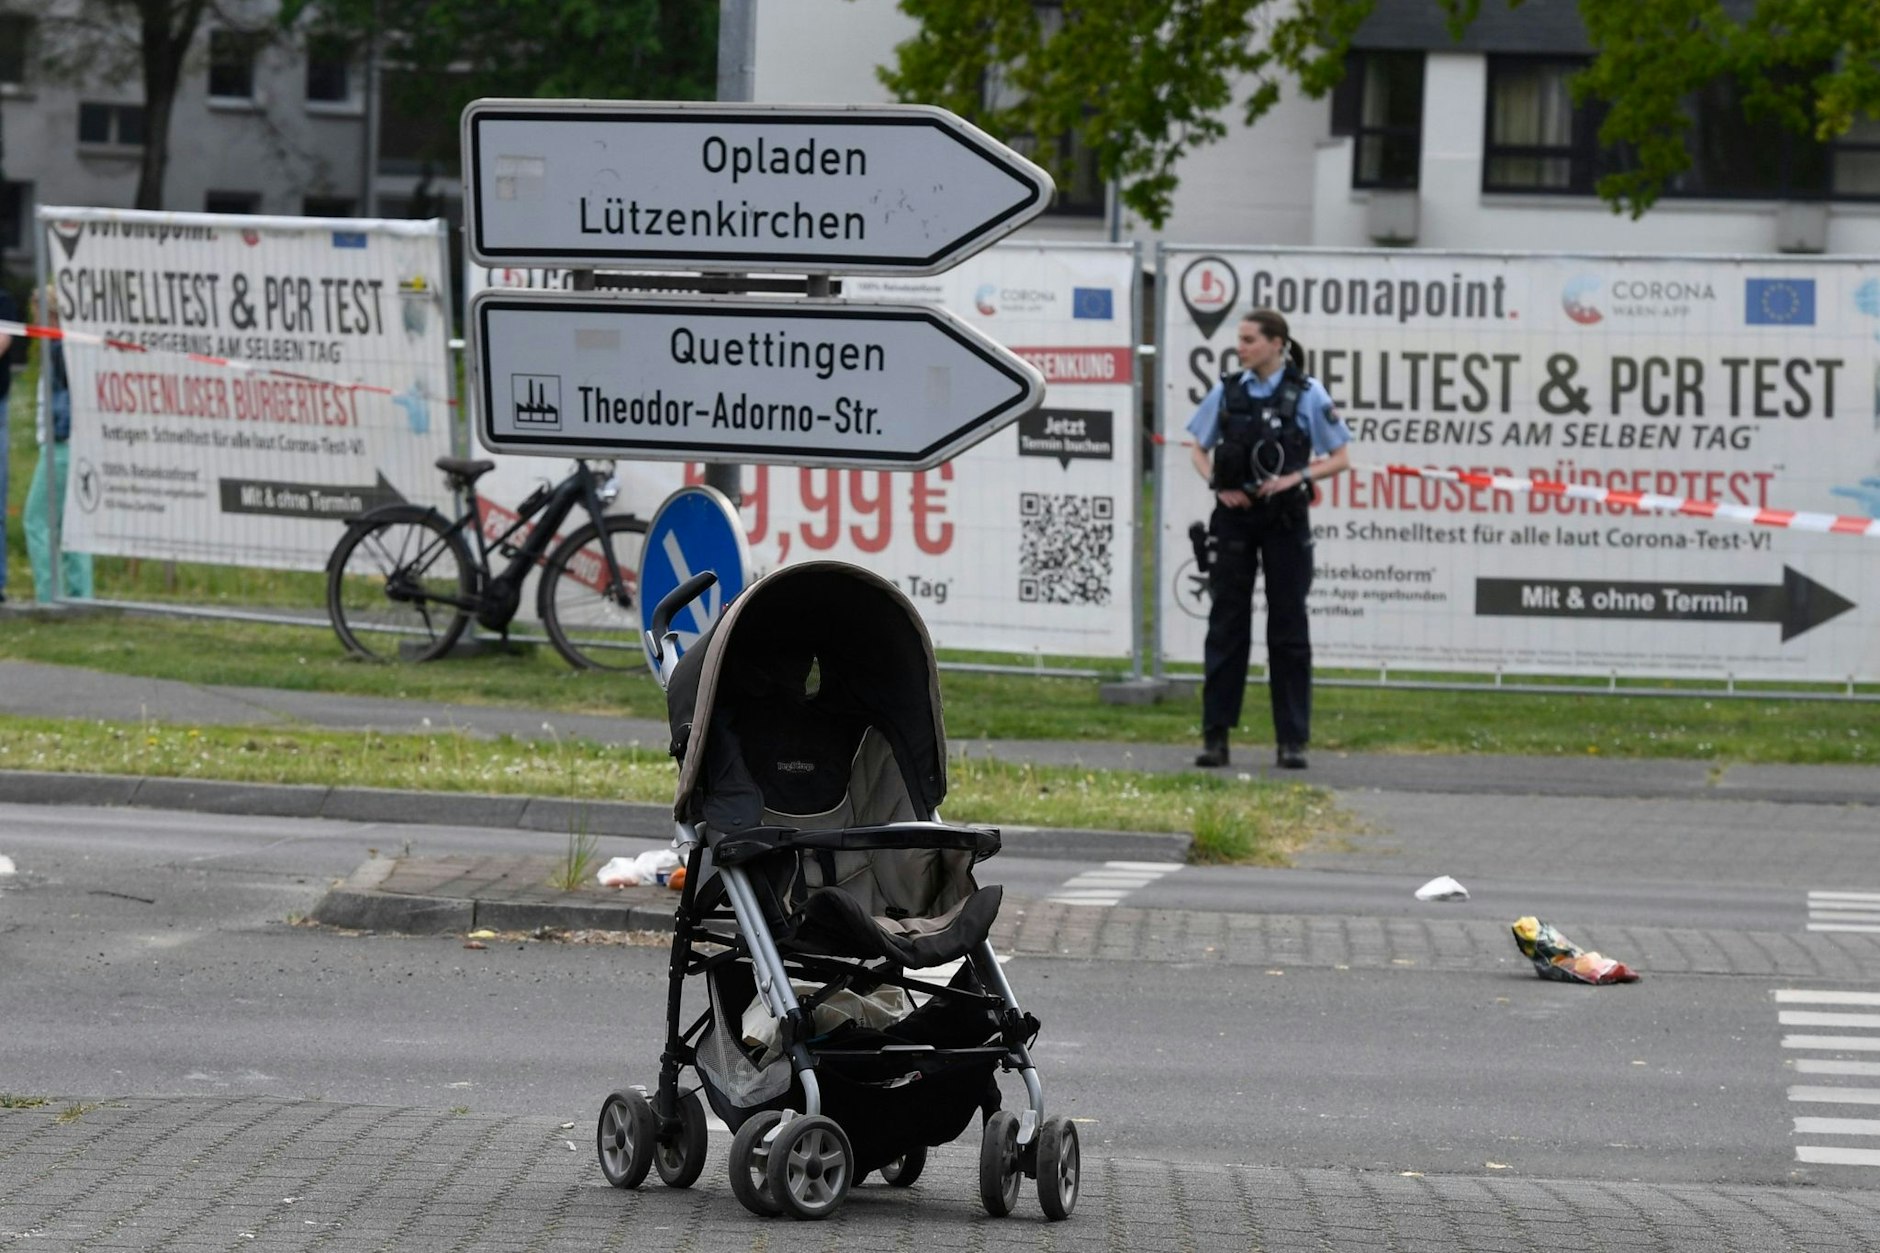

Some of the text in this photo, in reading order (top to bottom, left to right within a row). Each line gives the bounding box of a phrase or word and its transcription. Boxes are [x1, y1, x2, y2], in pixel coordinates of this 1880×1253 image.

[702, 136, 866, 183] Opladen
[580, 198, 866, 240] Lützenkirchen
[58, 268, 383, 335] SCHNELLTEST & PCR TEST
[1252, 271, 1519, 323] Coronapoint.
[1613, 281, 1715, 300] CORONA
[140, 331, 212, 358] ERGEBNIS
[217, 337, 242, 358] AM
[246, 338, 302, 362] SELBEN
[671, 328, 885, 378] Quettingen
[96, 371, 229, 419] KOSTENLOSER
[1538, 353, 1592, 415] &
[1611, 356, 1704, 417] PCR
[1721, 358, 1844, 419] TEST
[578, 386, 882, 435] Theodor-Adorno-Str.
[1044, 417, 1086, 437] Jetzt
[1502, 422, 1553, 447] AM
[1562, 422, 1680, 449] SELBEN
[241, 486, 362, 512] Mit & ohne Termin
[908, 462, 954, 556] €
[1346, 522, 1465, 544] Schnelltest
[1473, 525, 1502, 546] für
[1510, 526, 1551, 546] alle
[1555, 526, 1599, 547] laut
[1607, 528, 1772, 550] Corona-Test-V!
[1522, 585, 1748, 613] Mit & ohne Termin
